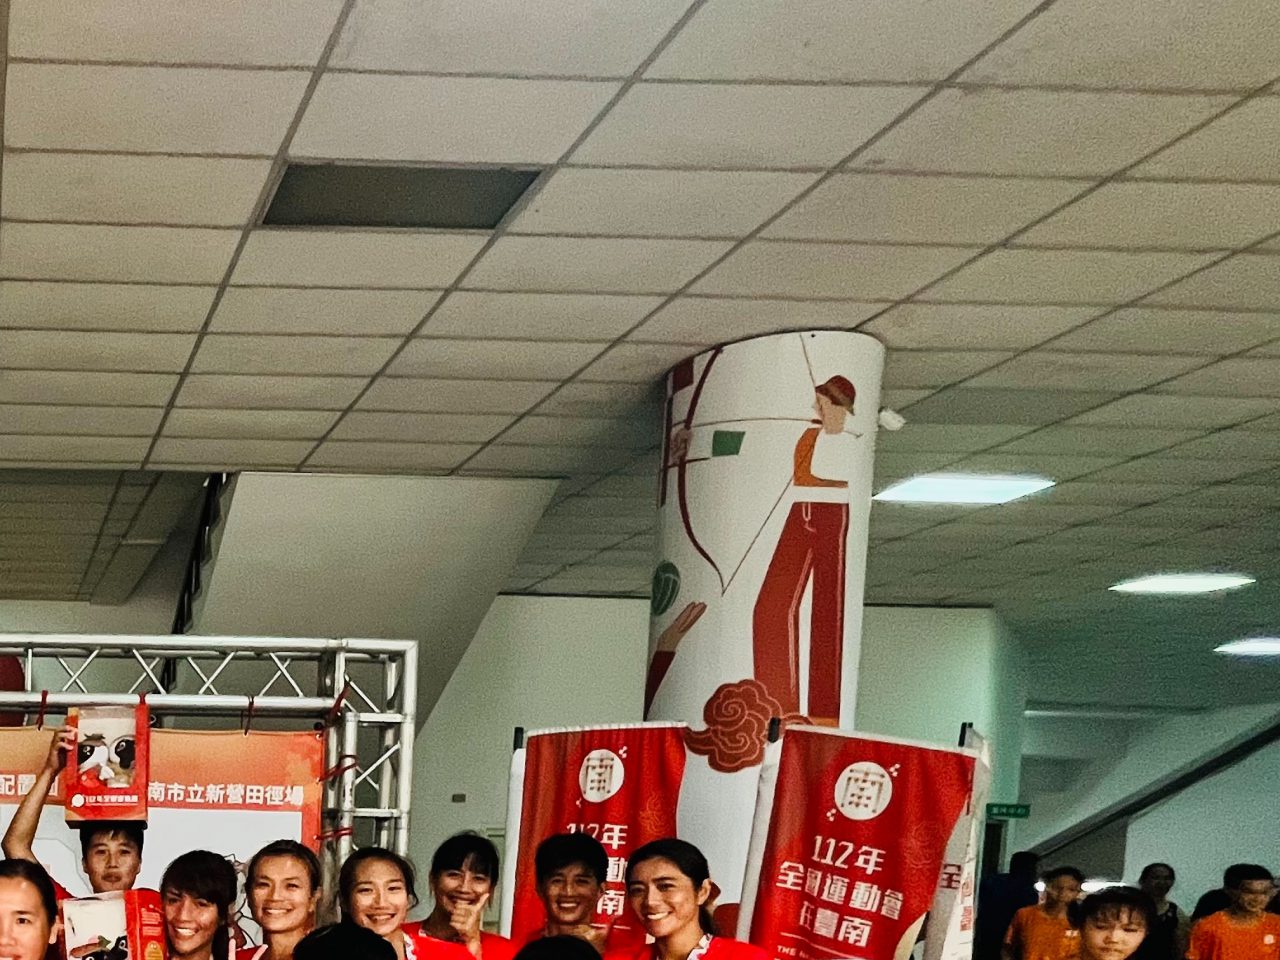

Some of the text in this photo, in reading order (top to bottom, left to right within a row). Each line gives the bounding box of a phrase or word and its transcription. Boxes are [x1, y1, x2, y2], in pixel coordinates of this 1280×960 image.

[811, 835, 886, 875] 112年
[776, 861, 904, 920] 全國運動會
[777, 945, 797, 956] THE
